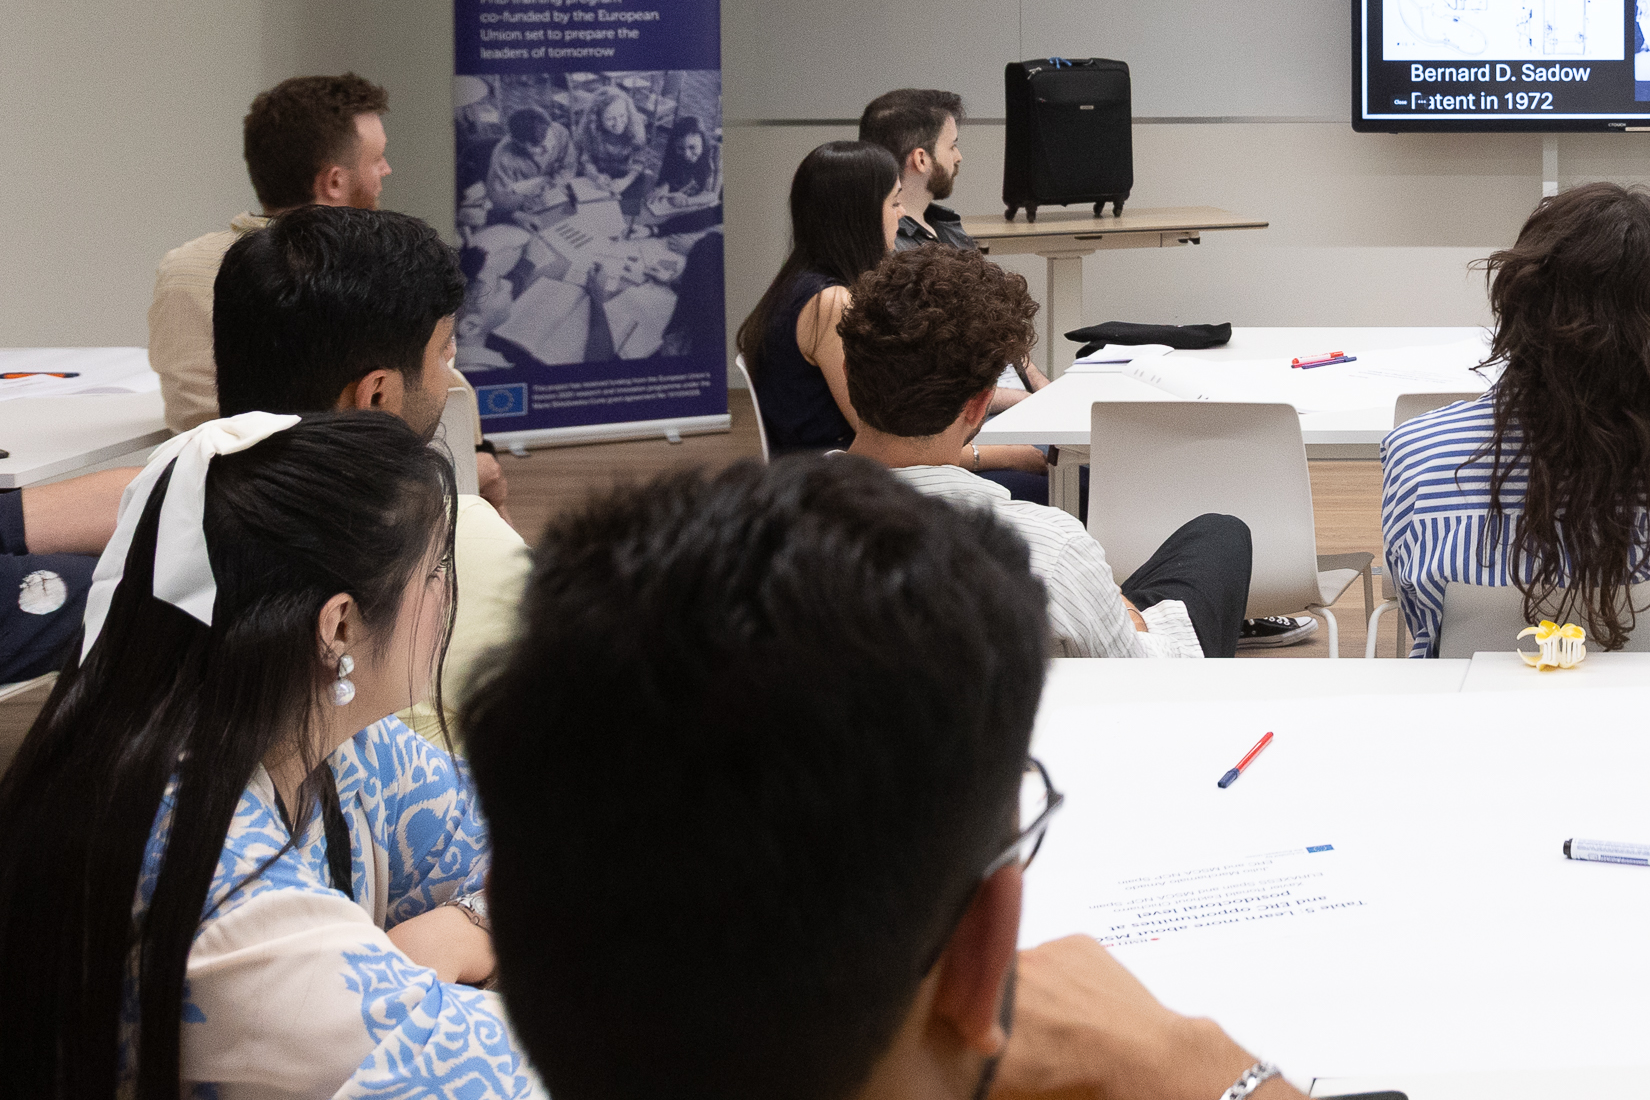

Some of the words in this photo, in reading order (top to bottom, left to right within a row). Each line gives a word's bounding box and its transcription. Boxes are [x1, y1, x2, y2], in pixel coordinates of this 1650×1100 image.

[480, 10, 551, 23] co-funded
[553, 10, 571, 24] by
[573, 10, 595, 22] the
[597, 10, 660, 24] European
[480, 28, 522, 40] Union
[524, 29, 544, 40] set
[547, 29, 561, 40] to
[564, 30, 615, 42] prepare
[617, 28, 639, 39] the
[480, 46, 529, 59] leaders
[531, 46, 546, 58] of
[547, 47, 615, 58] tomorrow
[1411, 64, 1489, 82] Bernard
[1495, 64, 1516, 82] D.
[1521, 64, 1591, 82] Sadow
[1480, 92, 1498, 110] in
[1504, 93, 1554, 110] 1972
[1182, 890, 1290, 912] postdoctoral
[1296, 896, 1326, 905] and
[1320, 901, 1367, 911] Table
[1256, 902, 1290, 912] ERC
[1132, 908, 1251, 927] opportunities
[1137, 908, 1177, 919] level
[1245, 911, 1294, 920] Learn
[1194, 918, 1240, 928] more
[1137, 926, 1187, 936] about
[1095, 934, 1130, 942] MSC
